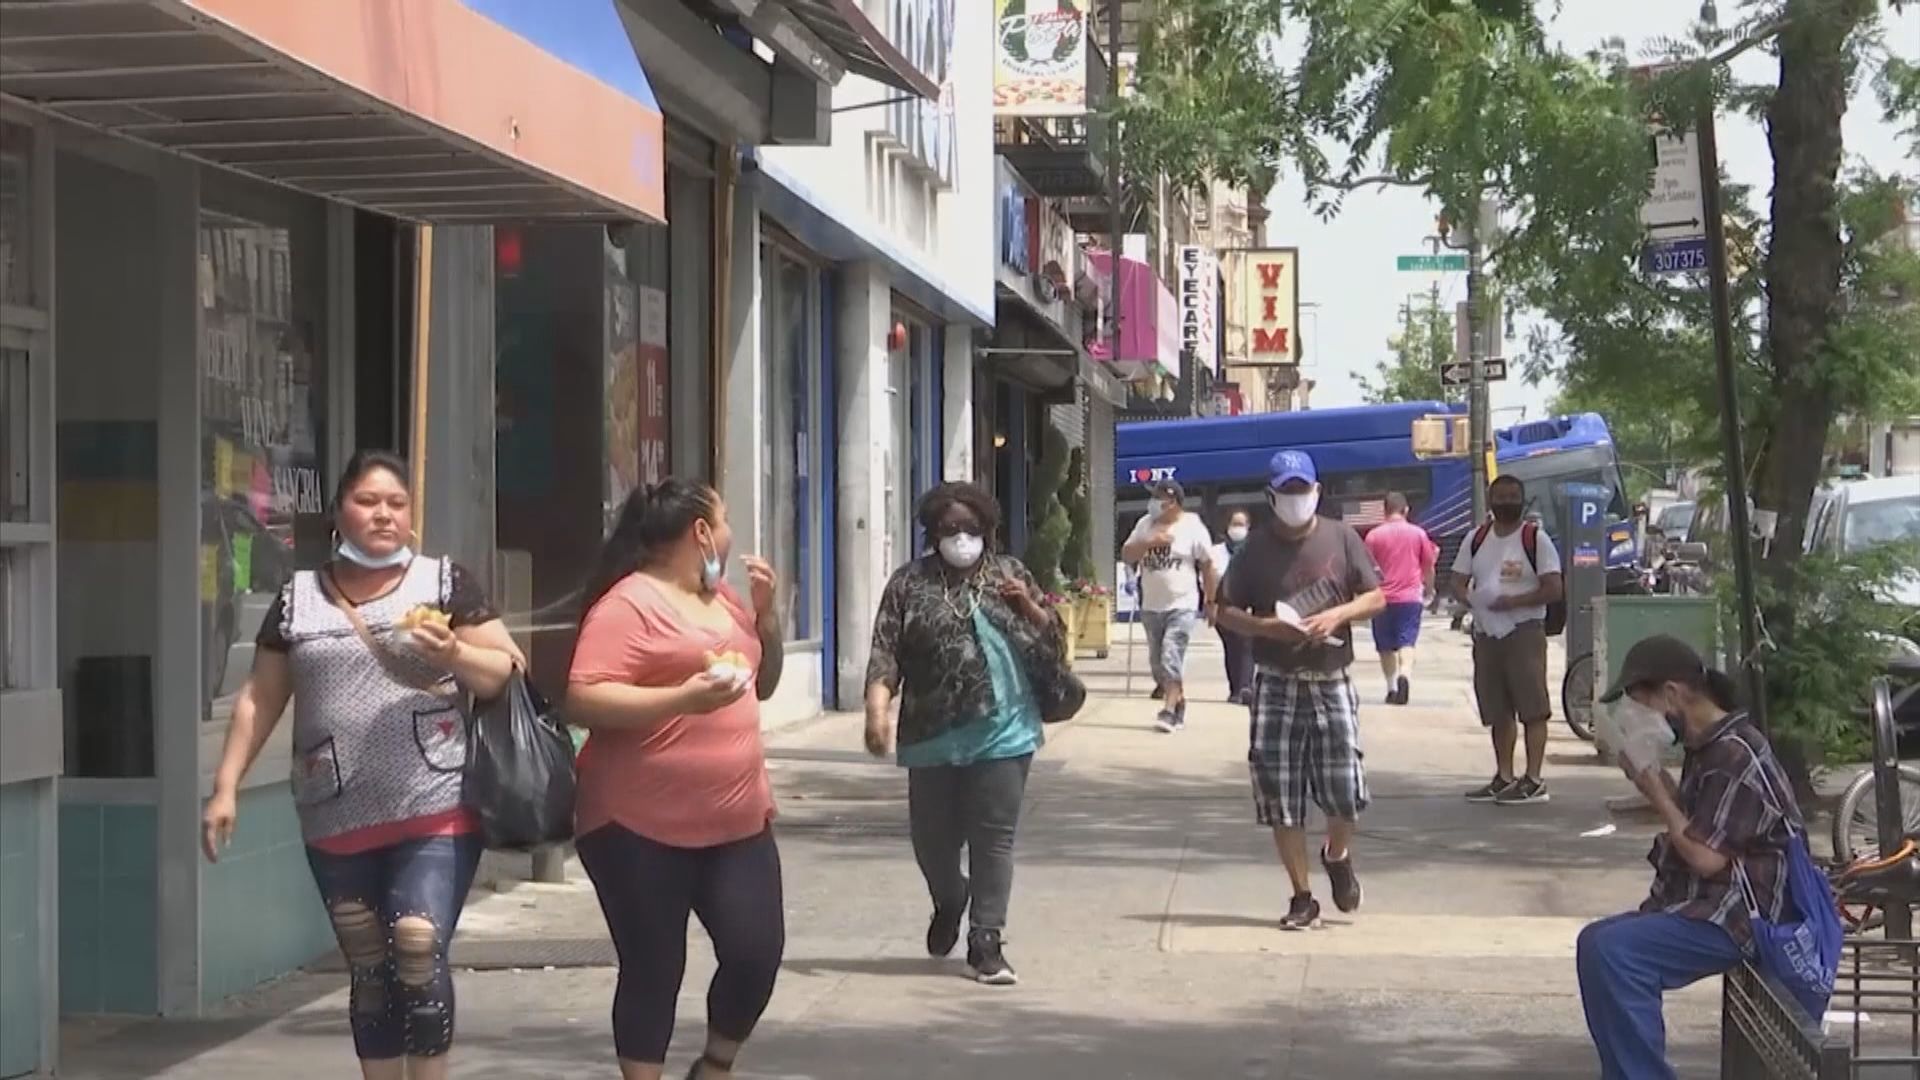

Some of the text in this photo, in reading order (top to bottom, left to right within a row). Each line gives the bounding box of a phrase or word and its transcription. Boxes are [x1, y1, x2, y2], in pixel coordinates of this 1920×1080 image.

[1000, 14, 1081, 46] Pizza
[1655, 250, 1706, 270] 307375
[1183, 248, 1199, 350] EYECARE
[1253, 263, 1289, 353] VIM
[272, 464, 323, 514] SANGRIA
[1151, 466, 1177, 482] NY
[1581, 502, 1597, 525] P
